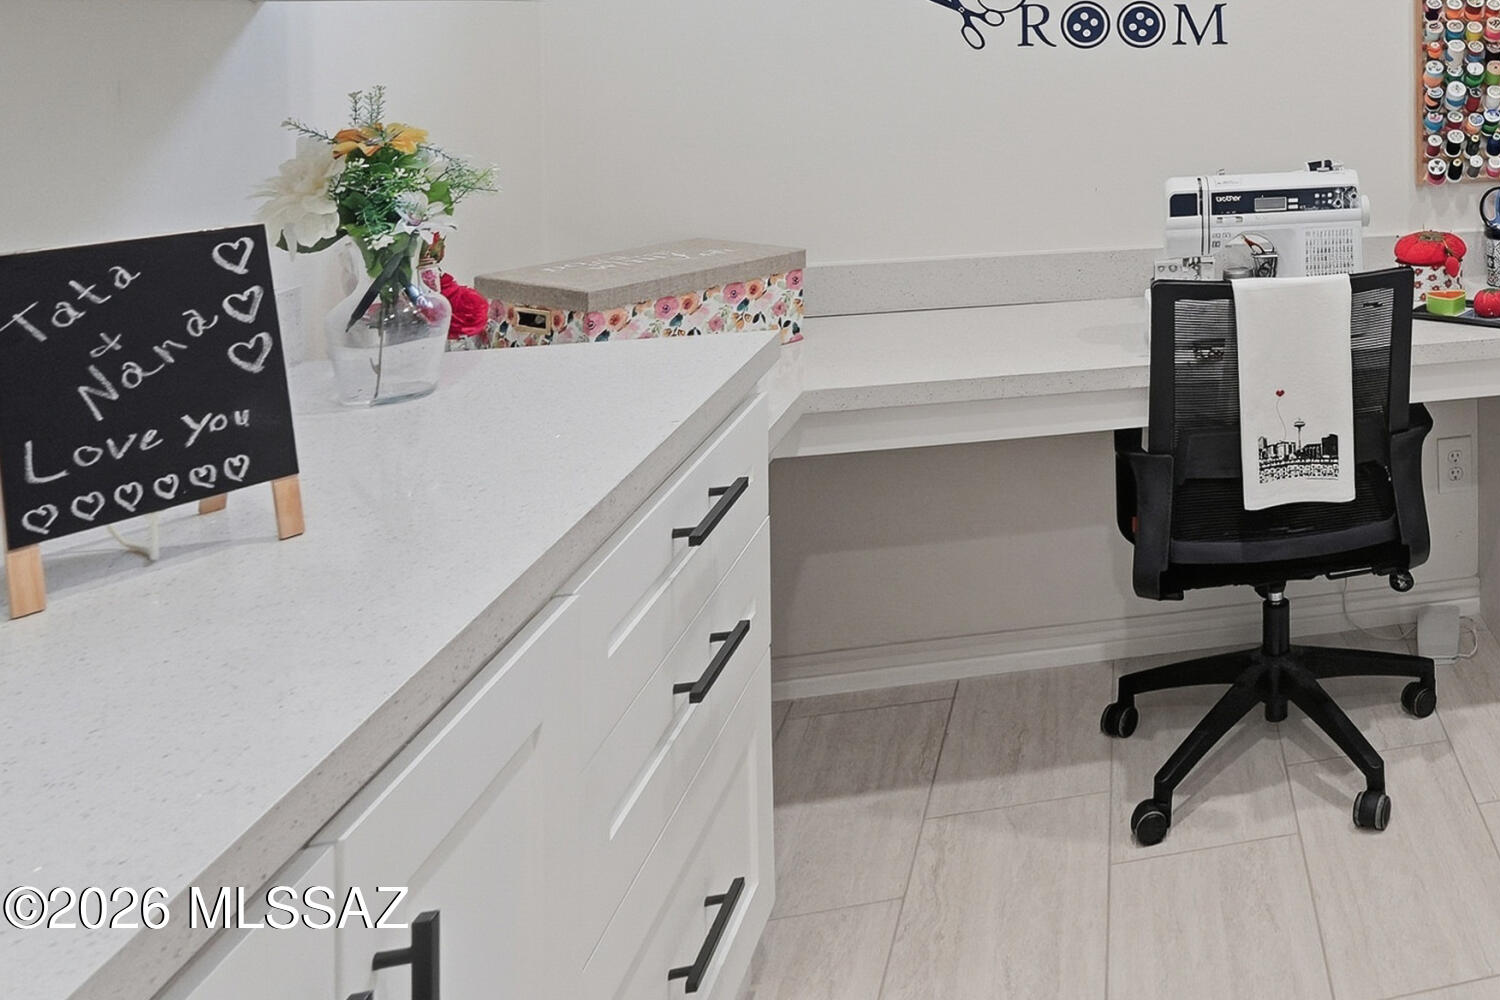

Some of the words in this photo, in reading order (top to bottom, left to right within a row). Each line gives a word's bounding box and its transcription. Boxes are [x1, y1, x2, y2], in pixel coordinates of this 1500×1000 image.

[1017, 0, 1229, 49] ROOM
[0, 266, 141, 343] Tata
[77, 309, 218, 421] Nana
[24, 430, 164, 484] Love
[181, 409, 250, 448] You
